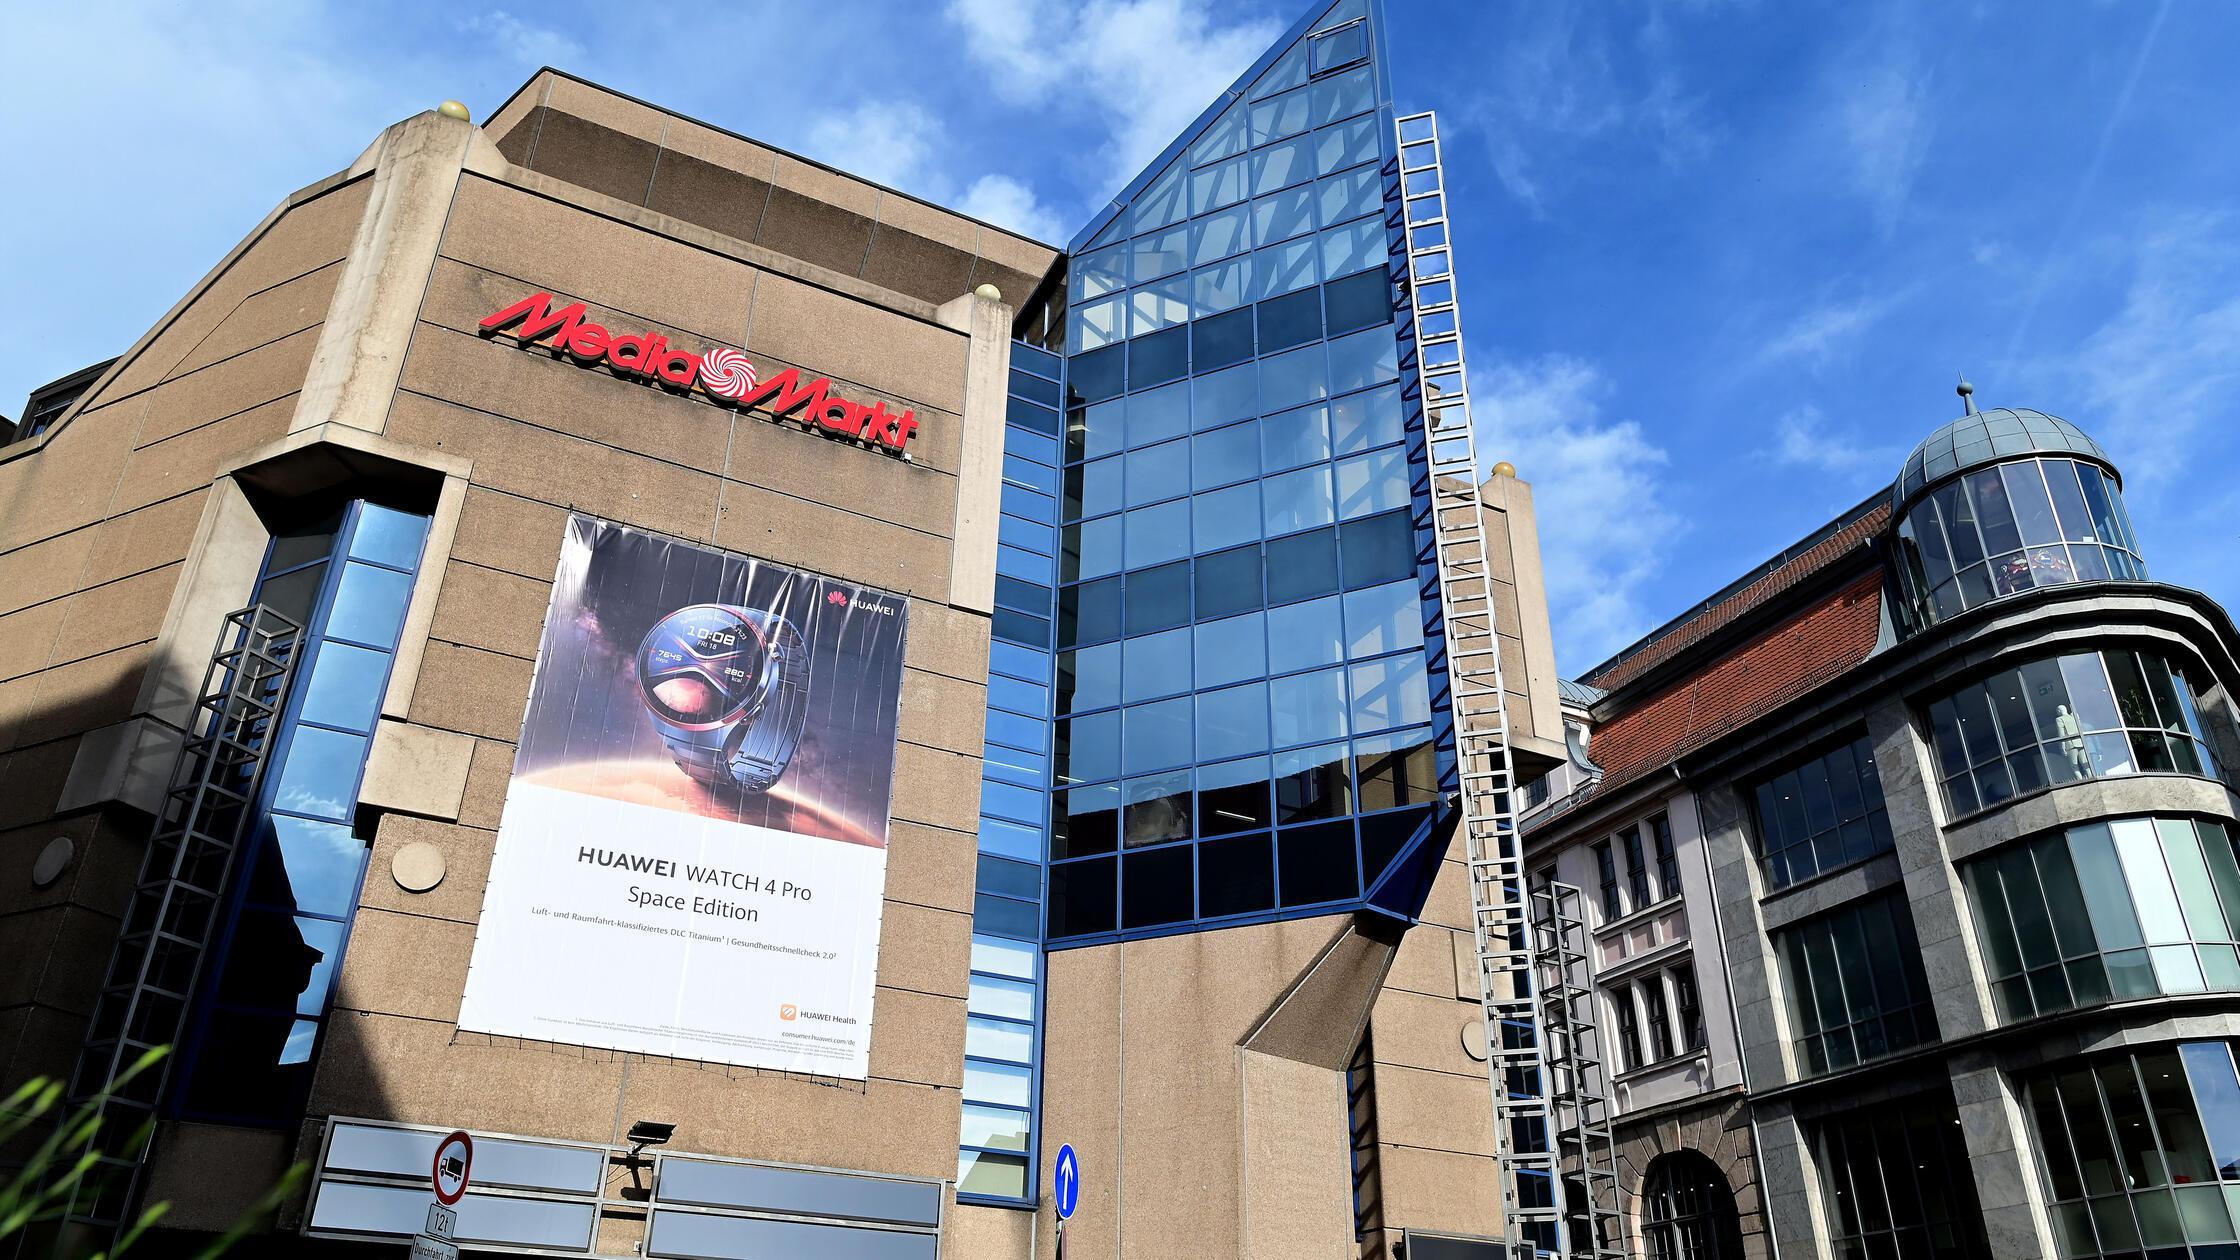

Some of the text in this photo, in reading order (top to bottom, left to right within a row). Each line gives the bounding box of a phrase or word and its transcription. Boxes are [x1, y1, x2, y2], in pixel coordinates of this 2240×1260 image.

[479, 291, 919, 449] Media Markt
[850, 599, 894, 616] HUAWEI
[687, 625, 735, 646] 10:08
[658, 649, 683, 661] 7645
[724, 667, 745, 678] 280
[577, 846, 812, 901] HUAWEI WATCH 4 Pro
[627, 885, 758, 922] Space Edition
[531, 906, 551, 916] Luft-
[553, 911, 570, 919] und
[571, 912, 668, 935] Raumfahrt-klassifiziertes
[670, 928, 686, 938] DLC
[731, 938, 821, 958] Gesundheitsschnellcheck
[800, 1011, 857, 1025] HUAWEI Health
[434, 1212, 449, 1233] 12t
[415, 1242, 444, 1260] Durchfahrt
